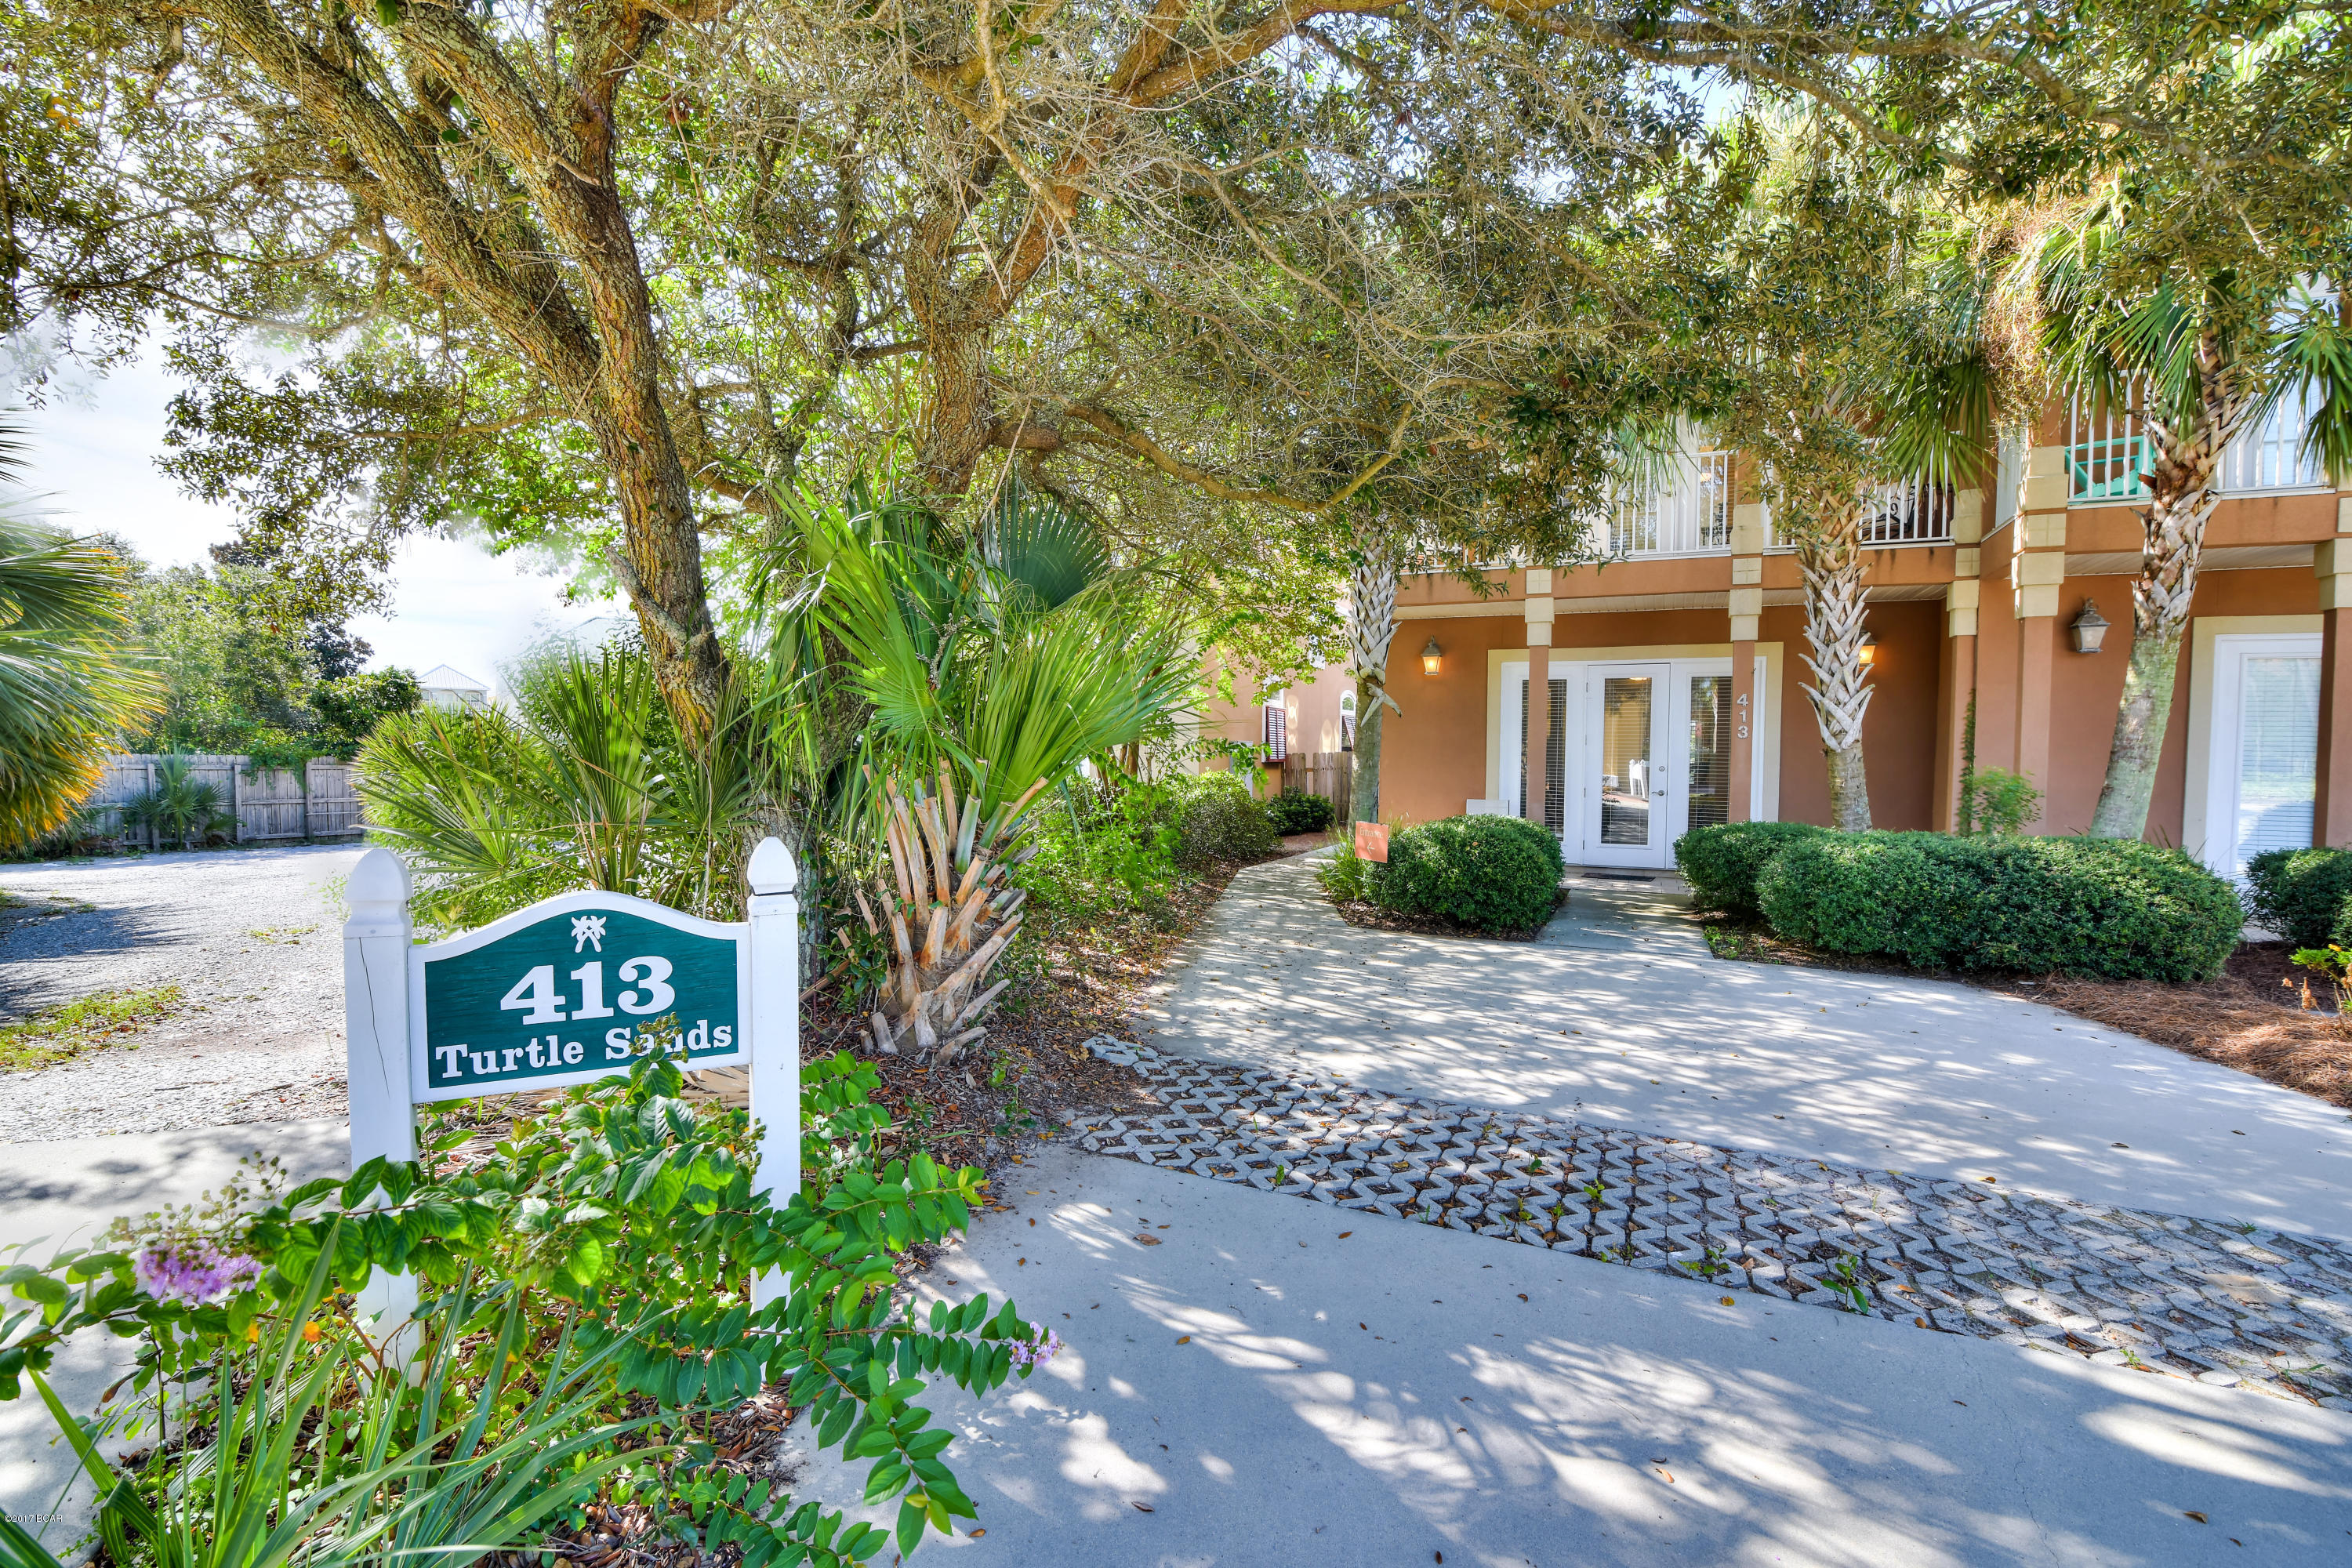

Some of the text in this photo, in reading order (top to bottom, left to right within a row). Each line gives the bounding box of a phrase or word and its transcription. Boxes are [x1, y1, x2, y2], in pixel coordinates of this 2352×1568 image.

[1737, 693, 1749, 739] 413
[500, 956, 676, 1025] 413
[435, 1019, 732, 1079] Turtle Sands
